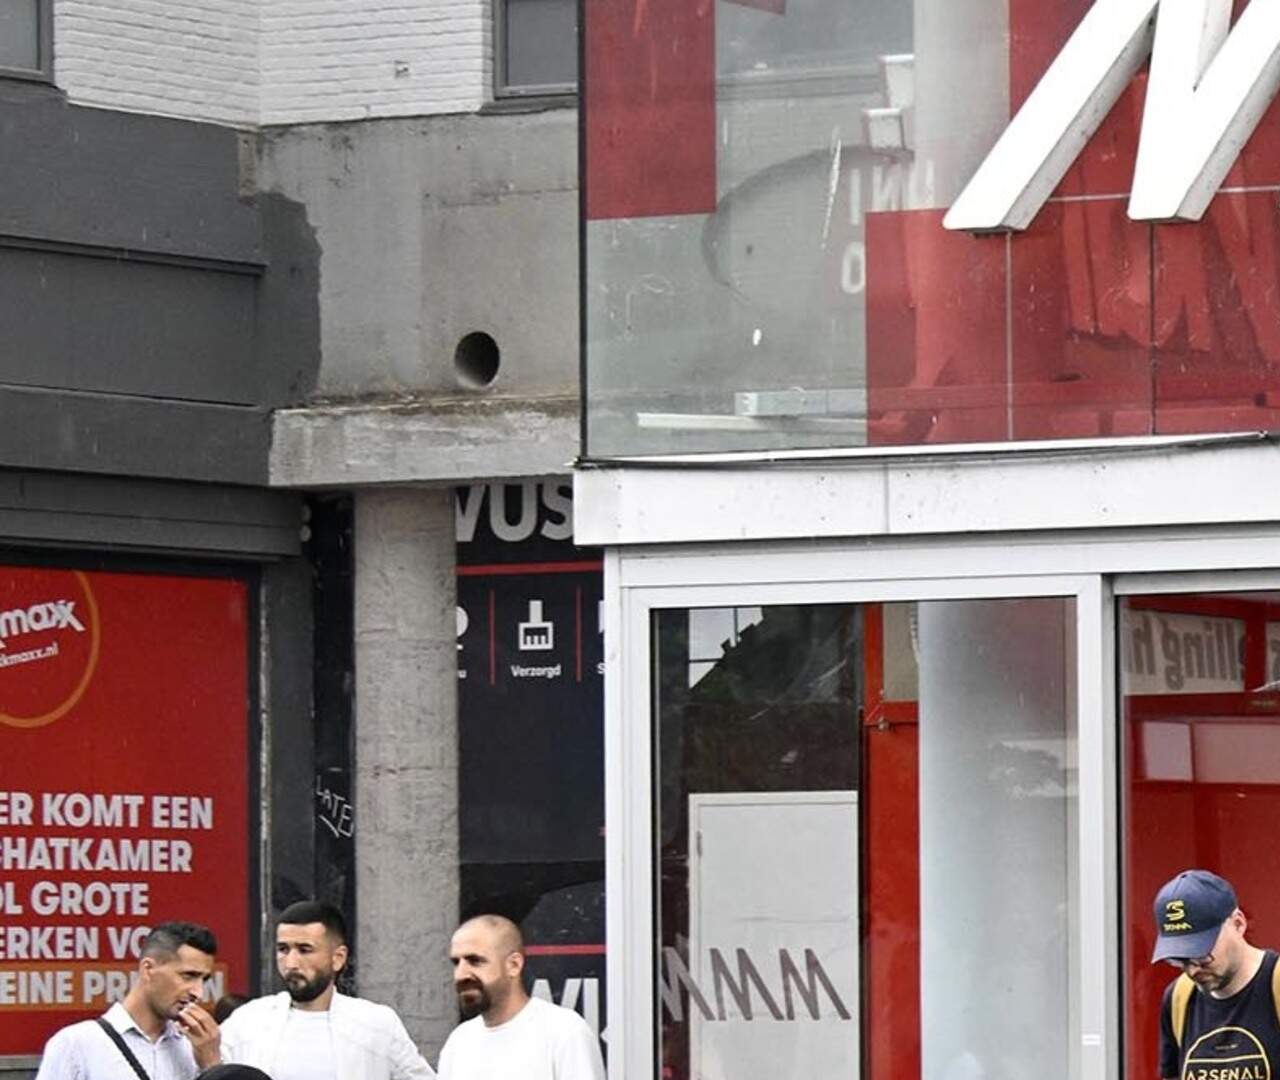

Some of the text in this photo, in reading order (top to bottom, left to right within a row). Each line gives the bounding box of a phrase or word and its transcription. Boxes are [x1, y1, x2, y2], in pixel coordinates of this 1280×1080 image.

[510, 663, 562, 678] Verzorgd
[42, 793, 144, 828] KOMT
[152, 796, 213, 829] EEN
[0, 836, 192, 872] HATKAMER
[31, 881, 149, 916] GROTE
